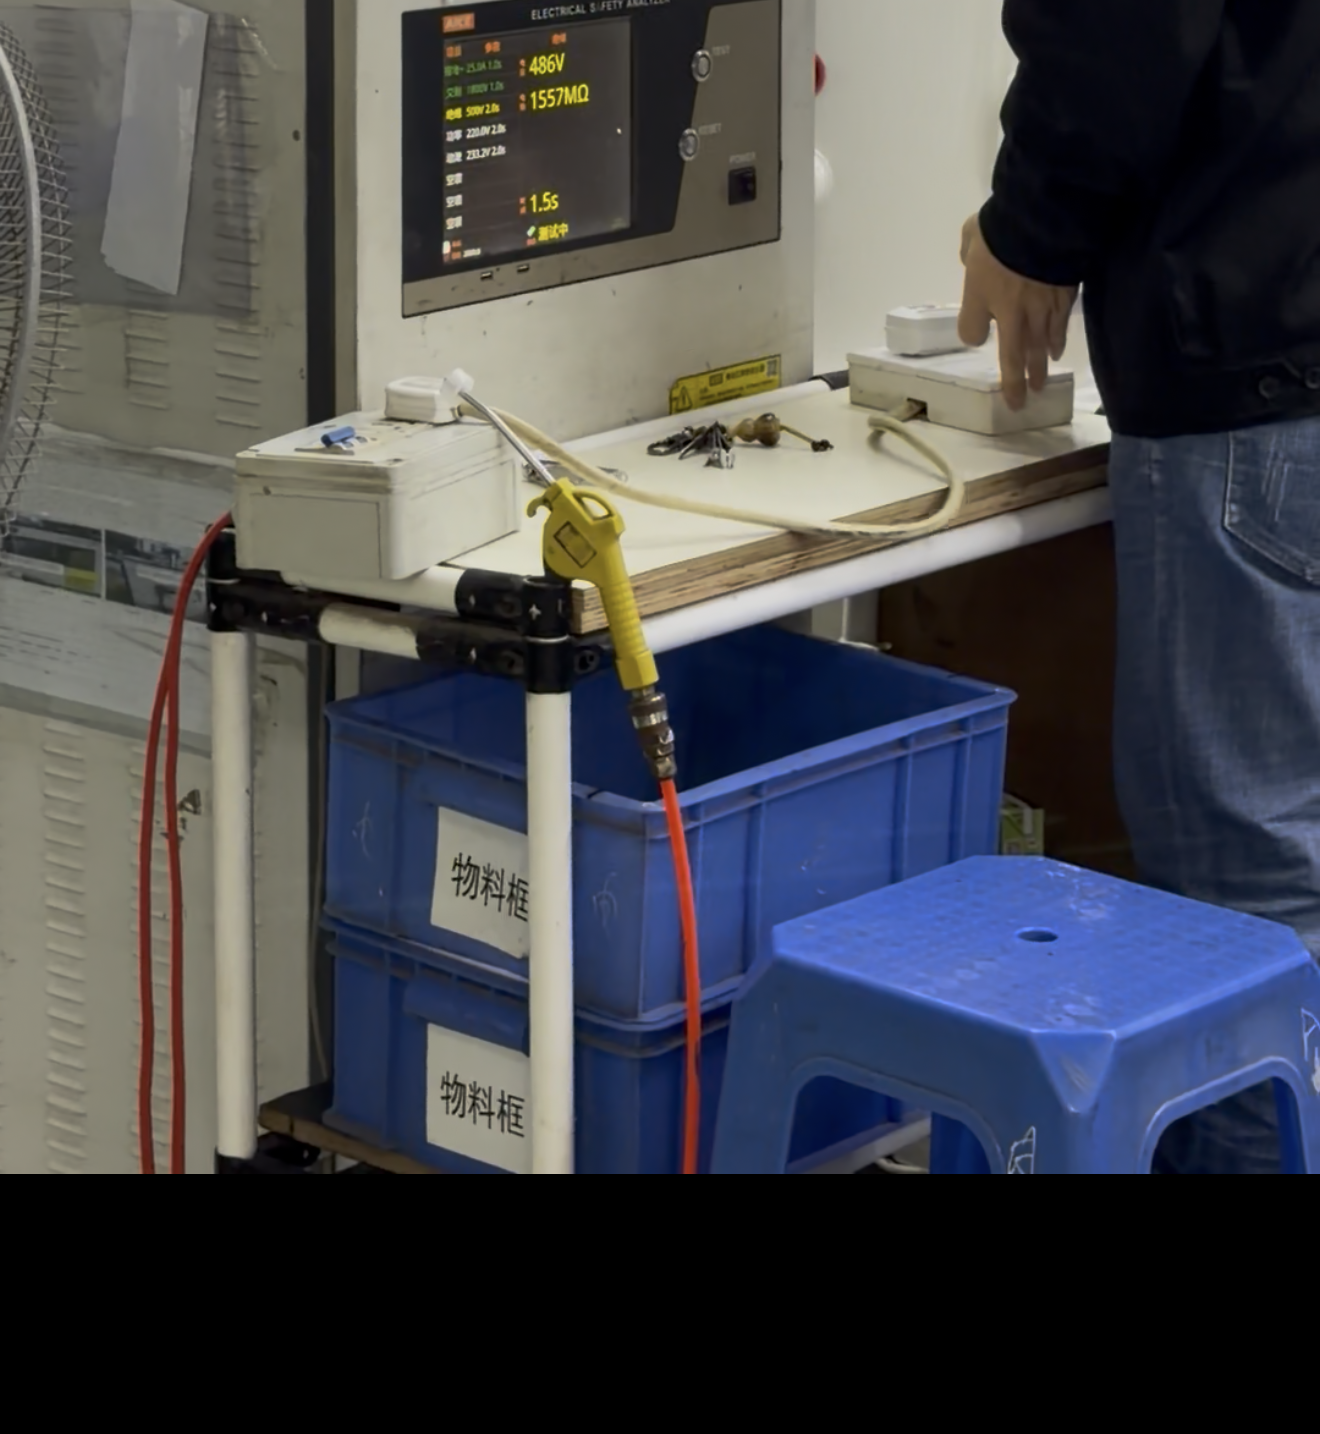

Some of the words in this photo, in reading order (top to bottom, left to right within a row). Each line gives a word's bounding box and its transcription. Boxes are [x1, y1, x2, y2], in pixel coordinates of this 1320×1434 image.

[531, 4, 586, 20] ELECTRICAL
[590, 0, 624, 13] SFETY
[529, 52, 565, 76] 486V
[530, 84, 589, 110] 1557MΩ
[530, 191, 559, 213] 1.5s
[451, 851, 529, 922] 物料框
[440, 1070, 525, 1138] 物料框
